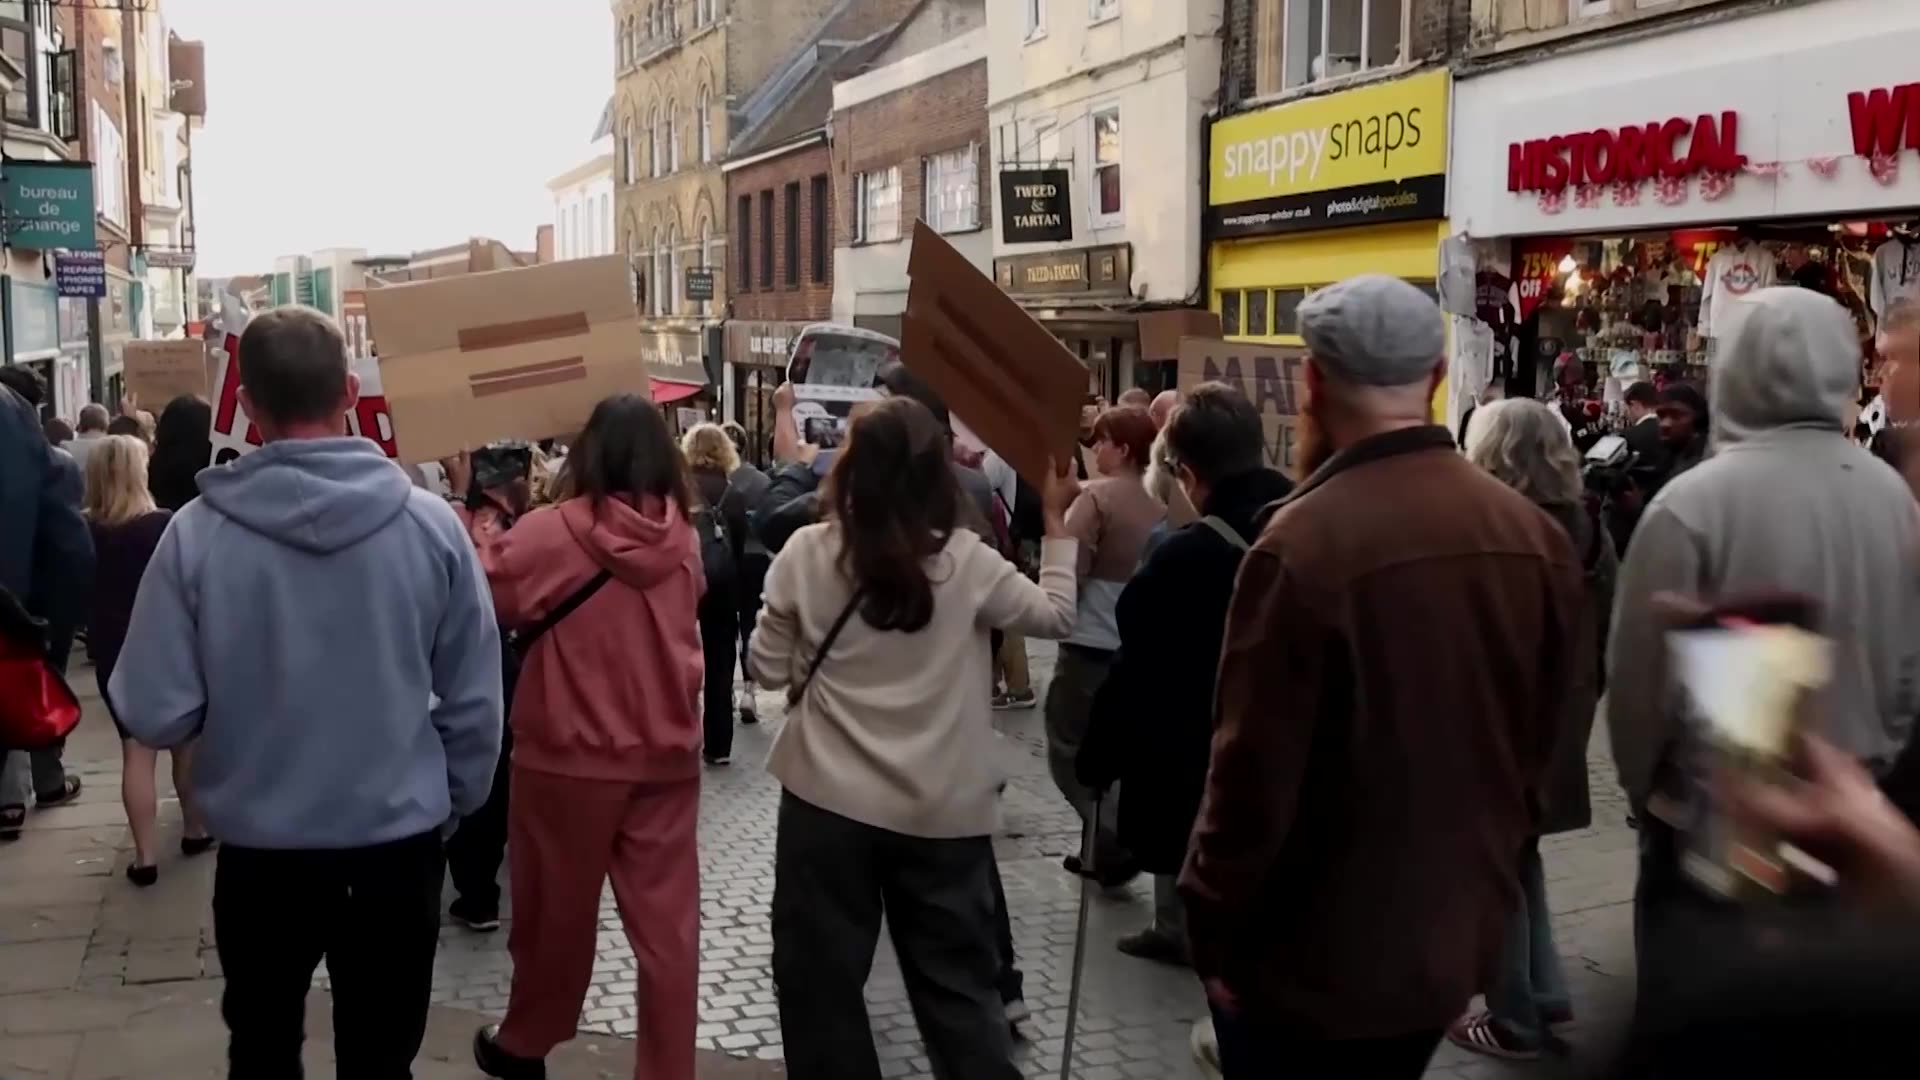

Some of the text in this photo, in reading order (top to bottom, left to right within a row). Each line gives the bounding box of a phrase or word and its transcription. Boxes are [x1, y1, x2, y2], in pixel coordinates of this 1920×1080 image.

[1508, 110, 1747, 193] HISTORICAL
[20, 185, 77, 199] bureau
[1014, 185, 1056, 198] TWEED
[39, 201, 60, 215] de
[1031, 199, 1045, 212] &
[1013, 214, 1061, 227] TARTAN
[63, 265, 103, 274] REPAIRS
[1522, 251, 1557, 277] 75%
[63, 275, 103, 284] PHONES
[64, 286, 96, 294] VAPES
[1520, 279, 1542, 298] OFF
